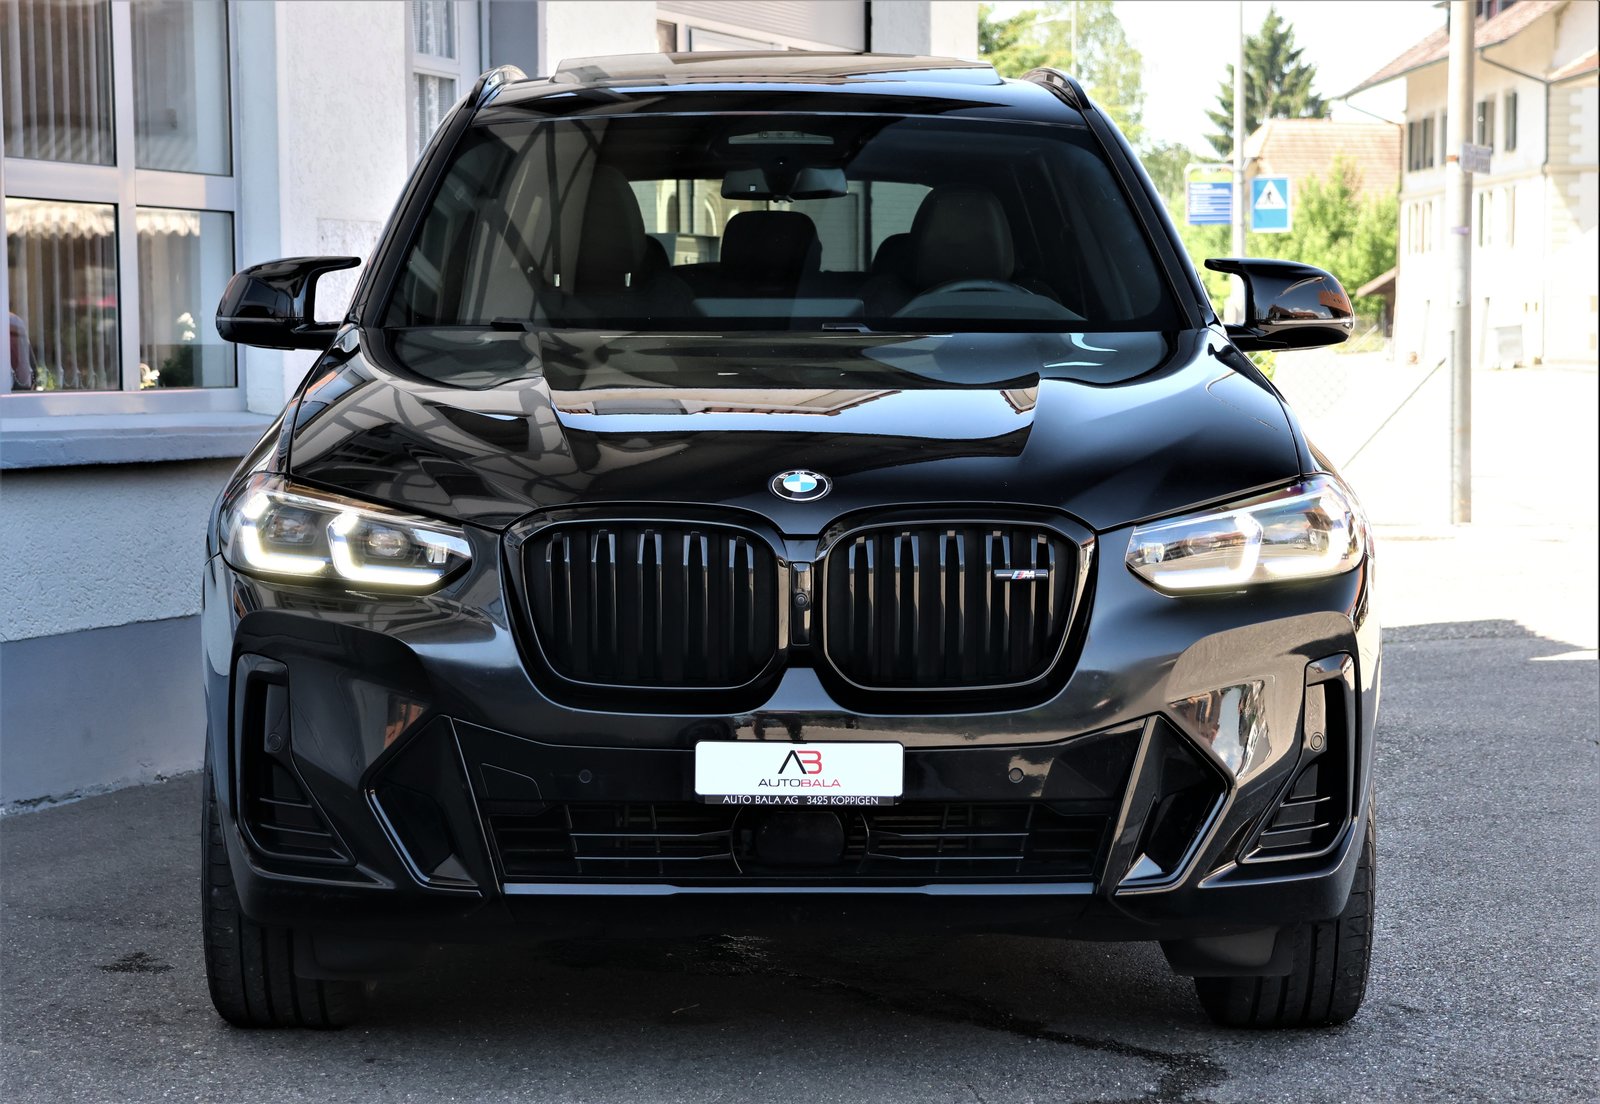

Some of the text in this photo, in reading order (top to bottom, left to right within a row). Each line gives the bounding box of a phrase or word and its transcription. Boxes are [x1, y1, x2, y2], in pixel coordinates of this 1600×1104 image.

[778, 750, 822, 774] AB
[758, 778, 841, 787] AUTOBALA
[723, 795, 879, 805] AUTO BALA AG 3425 KOPPIGEN
